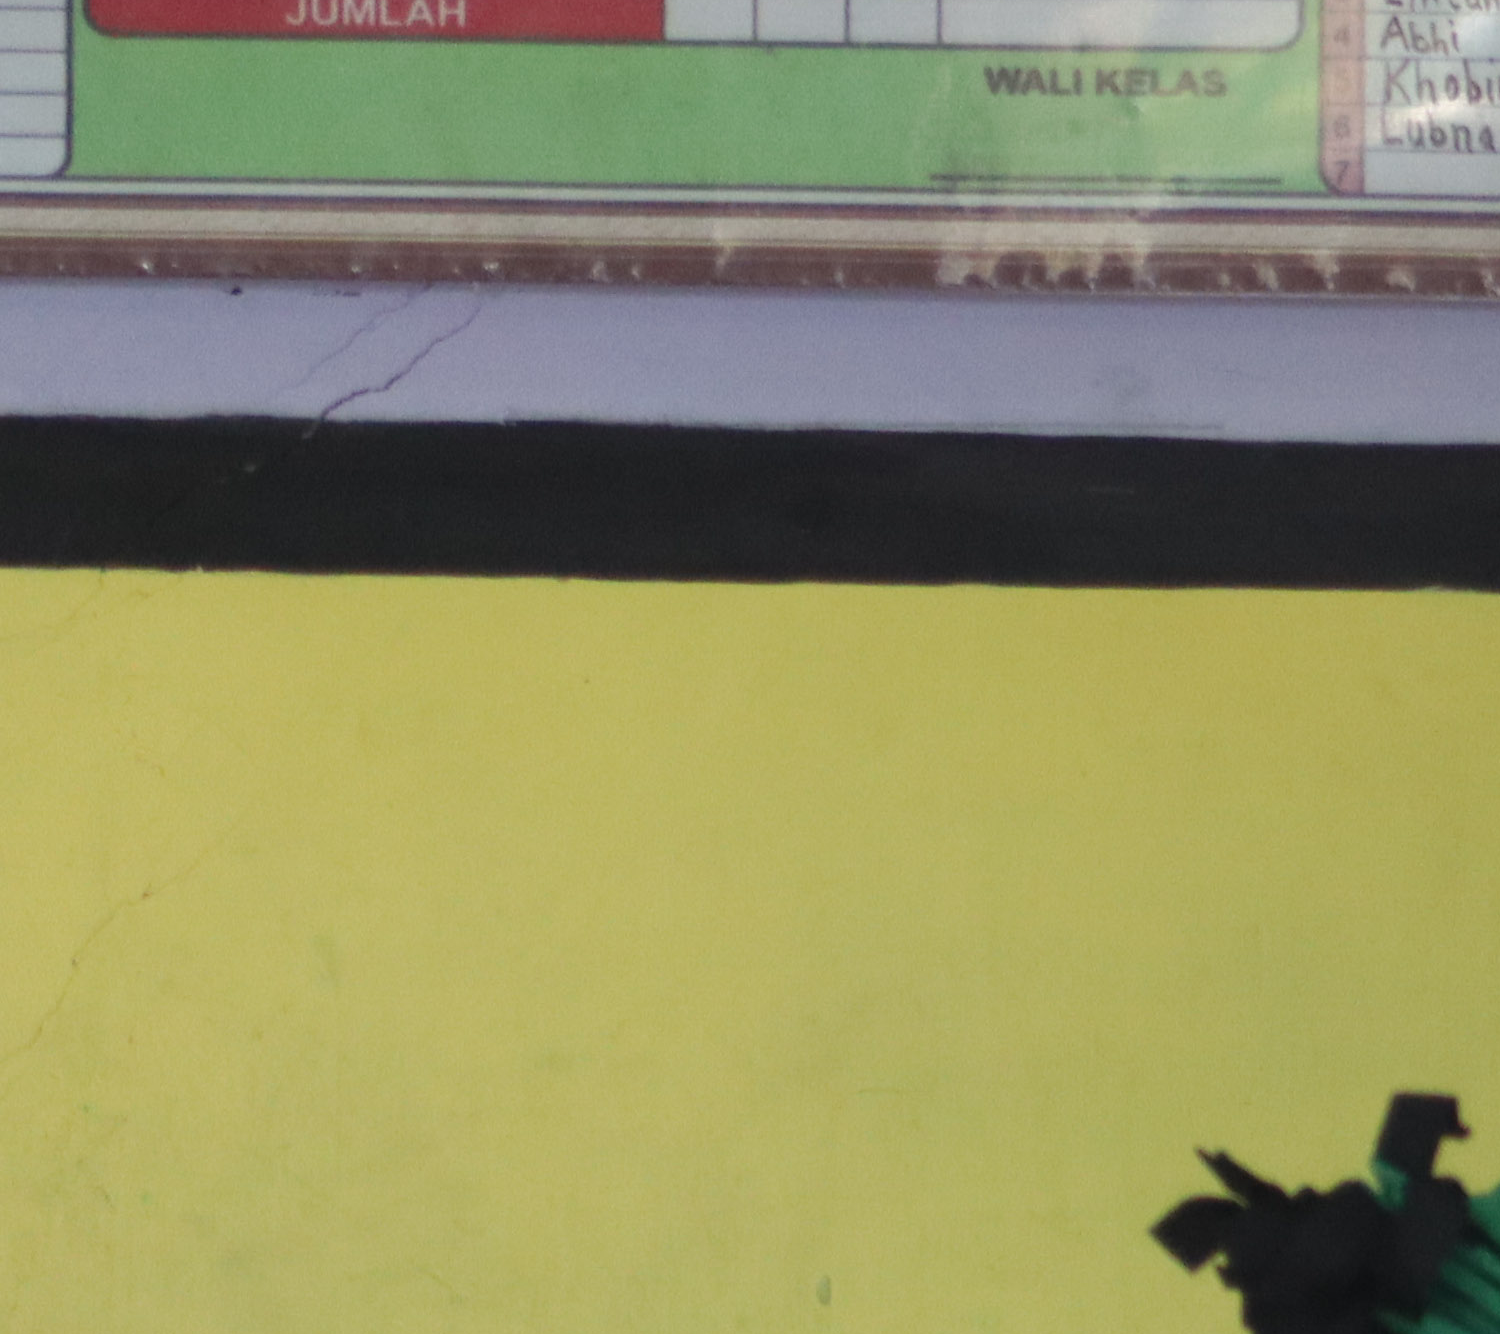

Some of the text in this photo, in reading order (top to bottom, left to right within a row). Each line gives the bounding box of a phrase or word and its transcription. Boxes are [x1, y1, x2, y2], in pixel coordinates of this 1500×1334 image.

[983, 65, 1228, 98] WALI KELAS
[1333, 160, 1350, 188] 7
